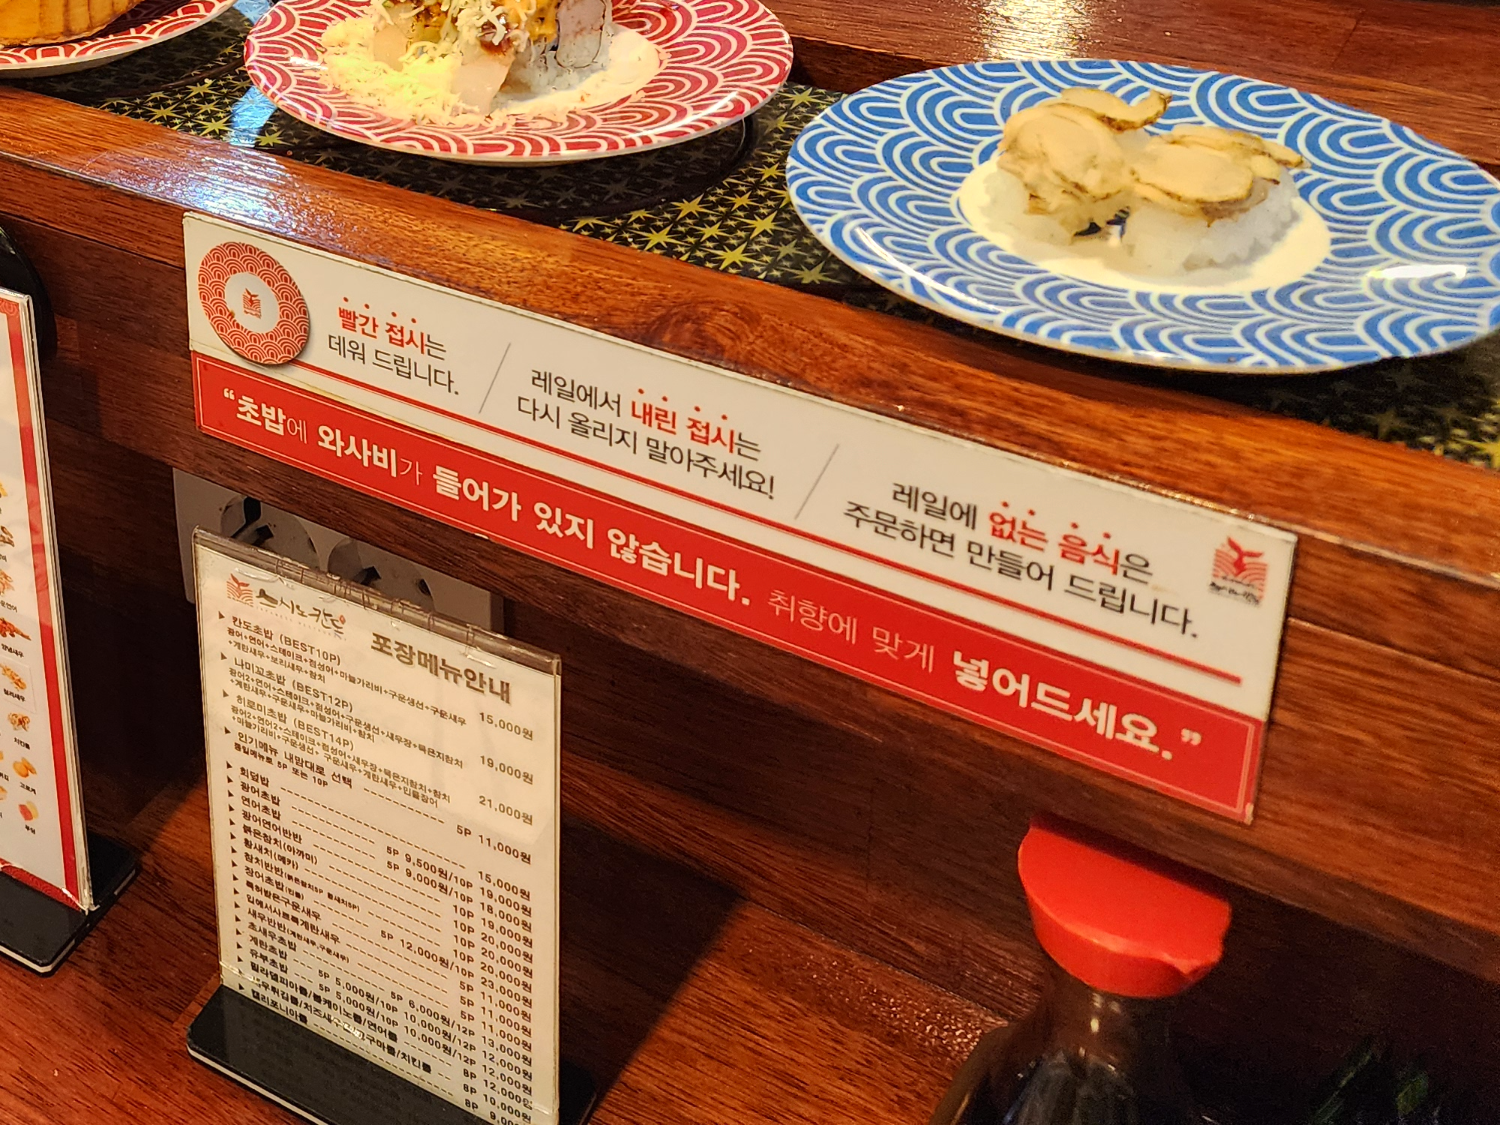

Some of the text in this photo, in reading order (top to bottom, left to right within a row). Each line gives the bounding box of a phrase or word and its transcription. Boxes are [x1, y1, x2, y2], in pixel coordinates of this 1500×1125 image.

[327, 330, 459, 396] 데워 드립니다.
[338, 305, 447, 363] 빨간 접시는
[531, 366, 761, 464] 레일에서 내린 접시는
[517, 393, 776, 502] 다시 올리지 말아주세요!
[317, 422, 422, 488] 와사비가
[432, 463, 521, 524] 들어가
[533, 499, 593, 550] 있지
[608, 526, 751, 608] 않습니다.
[767, 585, 858, 646] 취향에
[871, 622, 935, 674] 맞게
[891, 478, 1154, 588] 레일에 없는 음식은
[842, 498, 956, 561] 주문하면
[965, 537, 1055, 593] 만들어
[1063, 569, 1202, 641] 드립니다.
[279, 632, 340, 667] (BEST10P)
[370, 630, 510, 705] 포장메뉴안내
[292, 679, 353, 713] (BEST12P)
[293, 717, 354, 752] (BEST14P)
[479, 710, 533, 741] 15,000원
[238, 730, 530, 865] 인기메뉴 내맘대로 선택 5P 11,000원
[312, 775, 328, 789] 10P
[480, 753, 533, 785] 19,000원
[239, 765, 530, 902] 회덮밥 15,000원
[478, 793, 532, 826] 21,000원
[240, 780, 280, 807] 광어초밥
[386, 845, 398, 858] 5P
[480, 885, 531, 918] 19,000원
[240, 794, 281, 822] 연어초밥
[387, 860, 399, 873] 5P
[480, 900, 531, 934] 18,000원
[241, 808, 532, 949] 광어연어반반 10P 19,000원
[380, 928, 393, 942] 5P
[481, 975, 531, 1009] 23,000원
[453, 918, 474, 937] 10P
[480, 930, 532, 964] 20,000원
[453, 933, 475, 952] 10P
[480, 945, 532, 979] 20,000원
[247, 919, 296, 952] 초새우초밥
[390, 990, 403, 1003] 5P
[481, 1033, 531, 1068] 13,000원
[453, 947, 474, 966] 10P
[480, 960, 531, 994] 20,000원
[248, 932, 287, 961] 계란초밥
[318, 968, 329, 982] 5P
[482, 1048, 532, 1082] 12,000원
[249, 946, 288, 975] 유부초밥
[318, 982, 330, 995] 5P
[482, 1062, 532, 1097] 12,000원
[459, 979, 474, 995] 5P
[480, 989, 531, 1024] 11,000원
[459, 994, 474, 1010] 5P
[480, 1004, 531, 1038] 11,000원
[460, 1009, 474, 1025] 5P
[481, 1019, 531, 1053] 11,000원
[463, 1067, 476, 1082] 8P
[463, 1082, 531, 1125] 8P 10,000원
[465, 1098, 478, 1112] 8P
